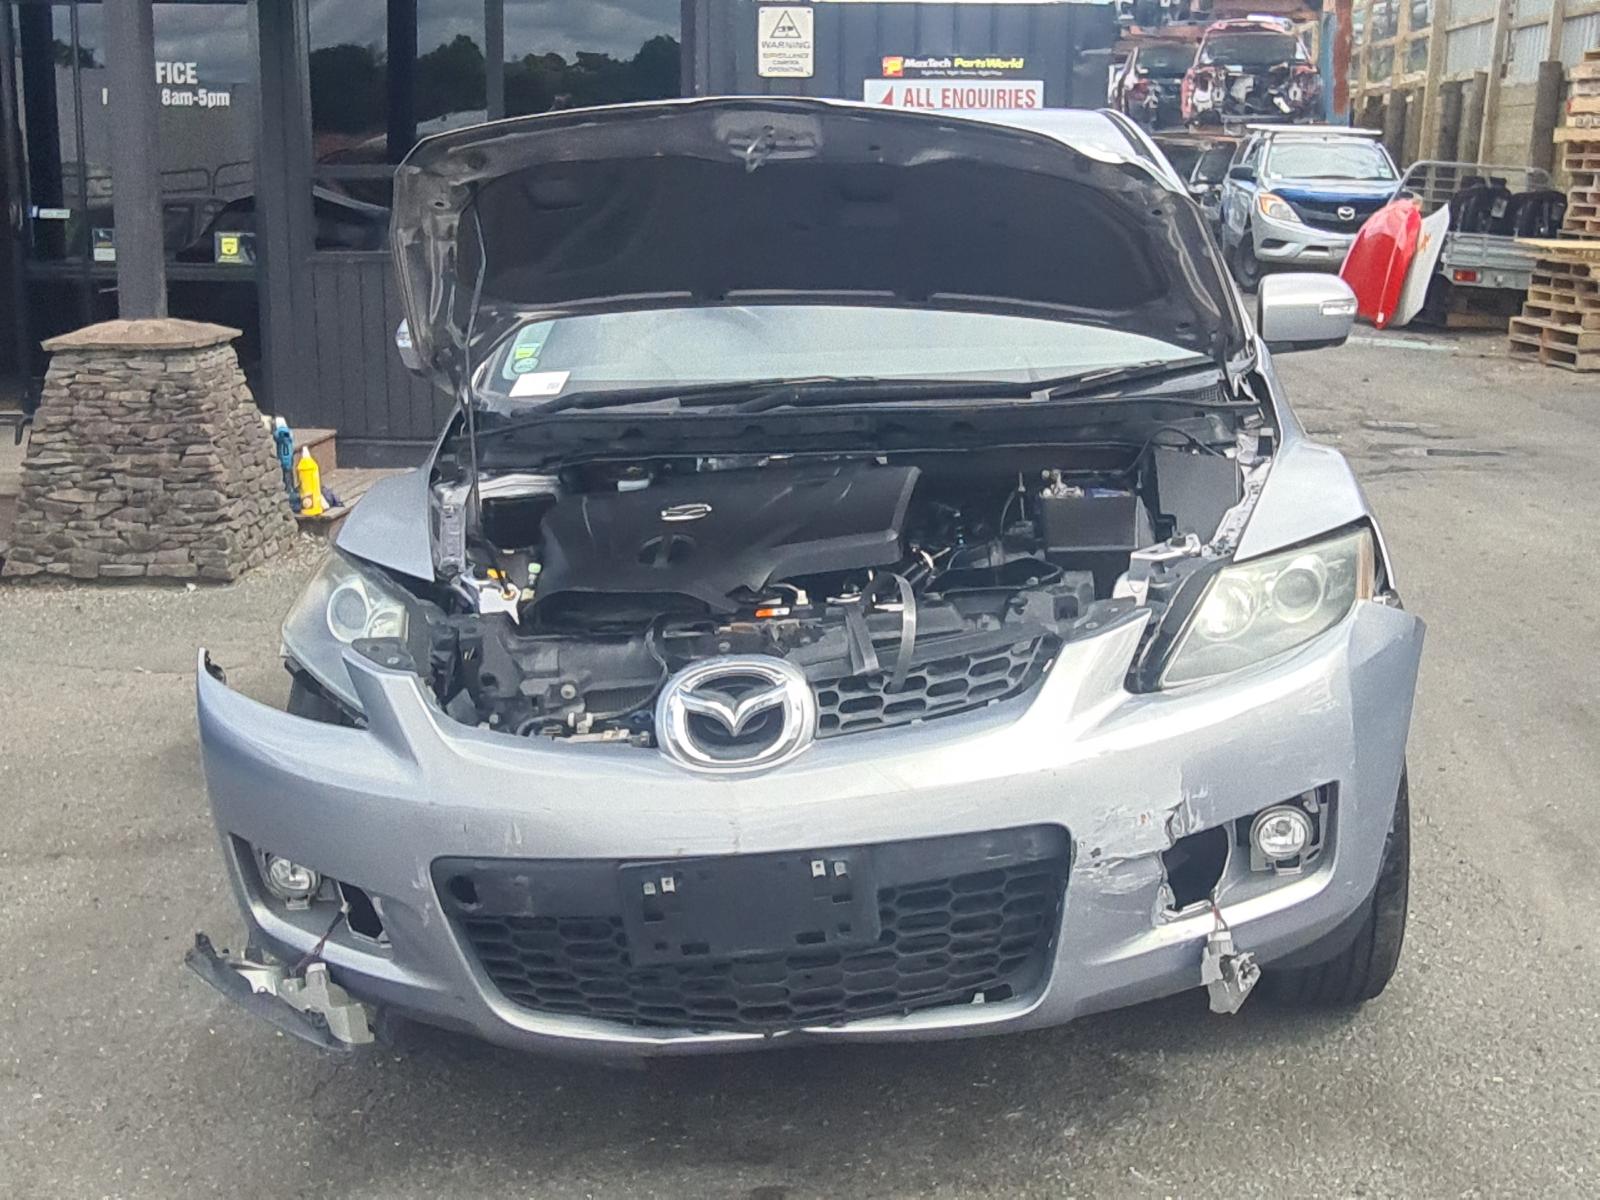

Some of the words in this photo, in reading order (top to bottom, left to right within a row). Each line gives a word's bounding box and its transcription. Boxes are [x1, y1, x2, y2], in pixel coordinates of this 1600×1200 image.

[761, 41, 811, 49] WARNING
[155, 61, 199, 84] FICE
[161, 88, 231, 109] 8am-5pm
[903, 88, 935, 108] ALL
[941, 88, 1037, 109] ENQUIRIES
